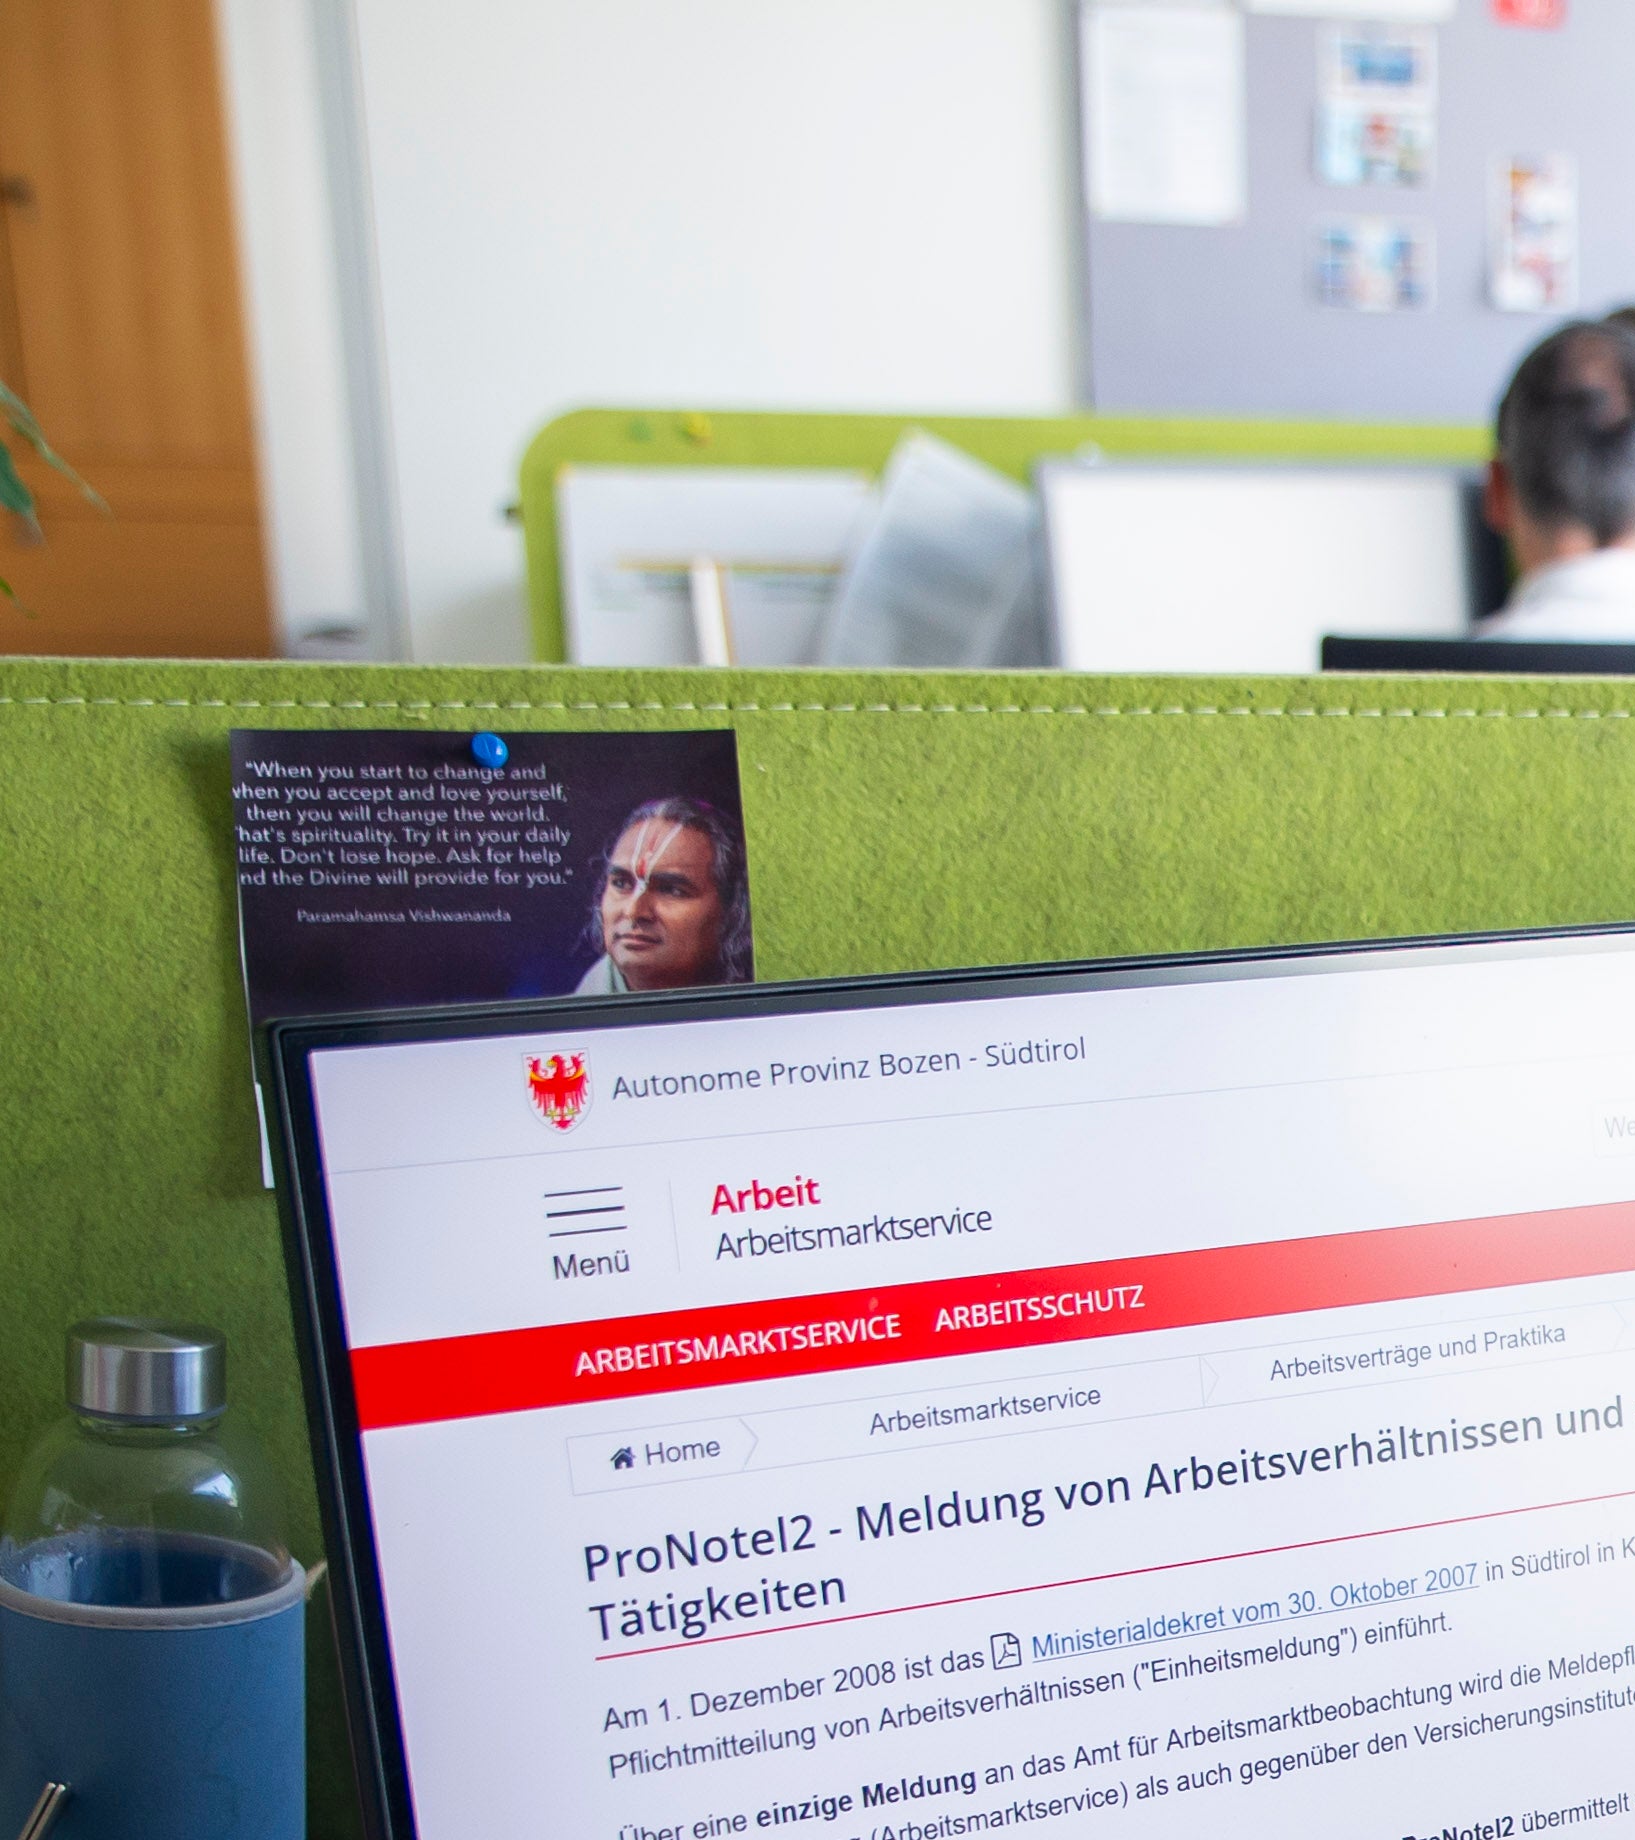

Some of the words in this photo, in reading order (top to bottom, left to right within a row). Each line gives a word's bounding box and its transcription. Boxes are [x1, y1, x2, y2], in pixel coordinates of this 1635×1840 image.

[318, 766, 354, 782] you
[360, 765, 402, 779] start
[408, 765, 428, 780] to
[433, 763, 505, 785] change
[511, 763, 546, 780] and
[246, 805, 291, 822] then
[297, 809, 333, 826] you
[338, 805, 371, 822] will
[377, 805, 448, 826] change
[454, 806, 485, 822] the
[490, 805, 550, 822] world.
[239, 847, 275, 864] life.
[281, 847, 335, 864] Don't
[340, 847, 381, 865] lose
[386, 847, 441, 867] hope.
[446, 847, 481, 864] Ask
[487, 847, 513, 864] for
[519, 847, 562, 867] help
[612, 1069, 761, 1100] Autonome
[770, 1056, 871, 1086] Provinz
[879, 1052, 960, 1077] Bozen
[985, 1035, 1085, 1068] Südtirol
[711, 1175, 821, 1216] Arbeit
[716, 1207, 992, 1260] Arbeitsmarktservice
[553, 1249, 630, 1280] Menü
[935, 1284, 1145, 1332] ARBEITSSCHUTZ
[576, 1314, 901, 1376] ARBEITSMARKTSERVICE
[1270, 1344, 1432, 1381] Arbeitsverträge
[1439, 1333, 1477, 1358] und
[1484, 1324, 1566, 1353] Praktika
[870, 1386, 1101, 1436] Arbeitsmarktservice
[645, 1440, 720, 1466] Home
[584, 1514, 816, 1582] ProNotel2
[856, 1488, 1045, 1541] Meldung
[1054, 1476, 1130, 1510] von
[1144, 1416, 1543, 1498] Arbeitsverhältnissen
[1556, 1394, 1623, 1436] und
[588, 1577, 845, 1641] Tätigkeiten
[603, 1707, 648, 1733] Am
[658, 1698, 681, 1722] 1.
[690, 1677, 825, 1717] Dezember
[833, 1660, 896, 1693] 2008
[904, 1654, 933, 1680] ist
[940, 1650, 985, 1674] das
[1032, 1605, 1226, 1659] Ministerialdekret
[1232, 1601, 1280, 1624] vom
[1288, 1590, 1322, 1615] 30.
[1330, 1577, 1418, 1607] Oktober
[1425, 1562, 1477, 1592] 2007
[1485, 1560, 1504, 1582] in
[1511, 1544, 1590, 1577] Südtirol
[1597, 1542, 1615, 1563] in
[609, 1726, 816, 1779] Pflichtmitteilung
[824, 1717, 870, 1740] von
[879, 1672, 1125, 1732] Arbeitsverhältnissen
[1364, 1611, 1452, 1645] einführt.
[693, 1814, 747, 1840] eine
[756, 1794, 853, 1828] einzige
[861, 1771, 976, 1809] Meldung
[985, 1764, 1014, 1785] an
[1022, 1754, 1066, 1778] das
[1074, 1740, 1121, 1769] Amt
[1127, 1735, 1159, 1759] für
[1166, 1683, 1452, 1752] Arbeitsmarktbeobachtung
[1458, 1669, 1503, 1697] wird
[1510, 1664, 1541, 1687] die
[1522, 1792, 1630, 1833] übermittelt
